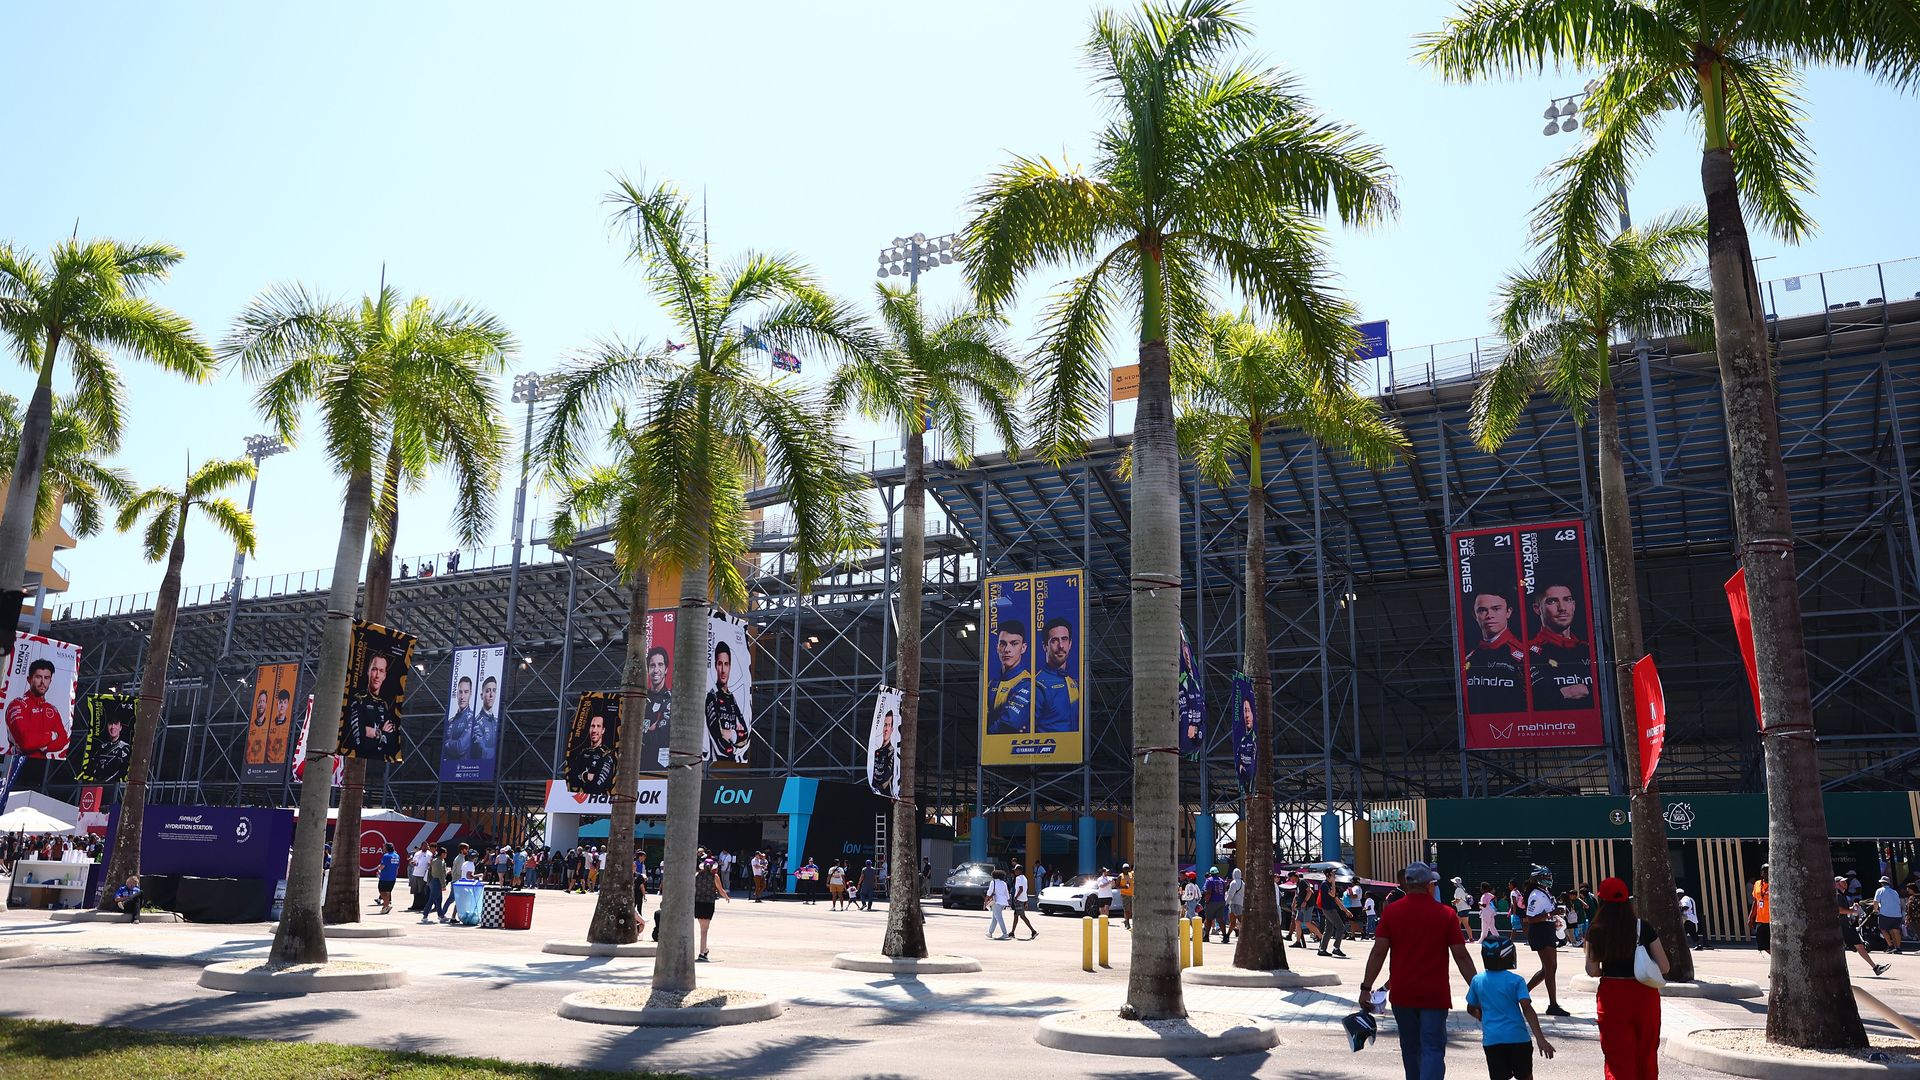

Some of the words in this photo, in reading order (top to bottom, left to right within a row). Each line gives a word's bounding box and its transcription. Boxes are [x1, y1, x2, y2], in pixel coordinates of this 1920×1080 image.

[1494, 534, 1510, 546] 21
[1554, 530, 1576, 542] 48
[1459, 540, 1469, 556] DE
[1530, 532, 1540, 564] Edoardo
[1521, 534, 1535, 594] MORTARA
[1460, 557, 1472, 594] VRIES
[1014, 582, 1028, 592] 22
[1036, 580, 1044, 590] DI
[1066, 578, 1077, 587] 11
[664, 614, 674, 622] 13
[1036, 594, 1044, 632] GRASSI
[56, 651, 75, 660] NISSAN
[15, 650, 25, 675] NATO
[452, 652, 460, 698] VANDOORNE
[1517, 722, 1576, 731] mahindra
[1371, 809, 1400, 820] SUPER
